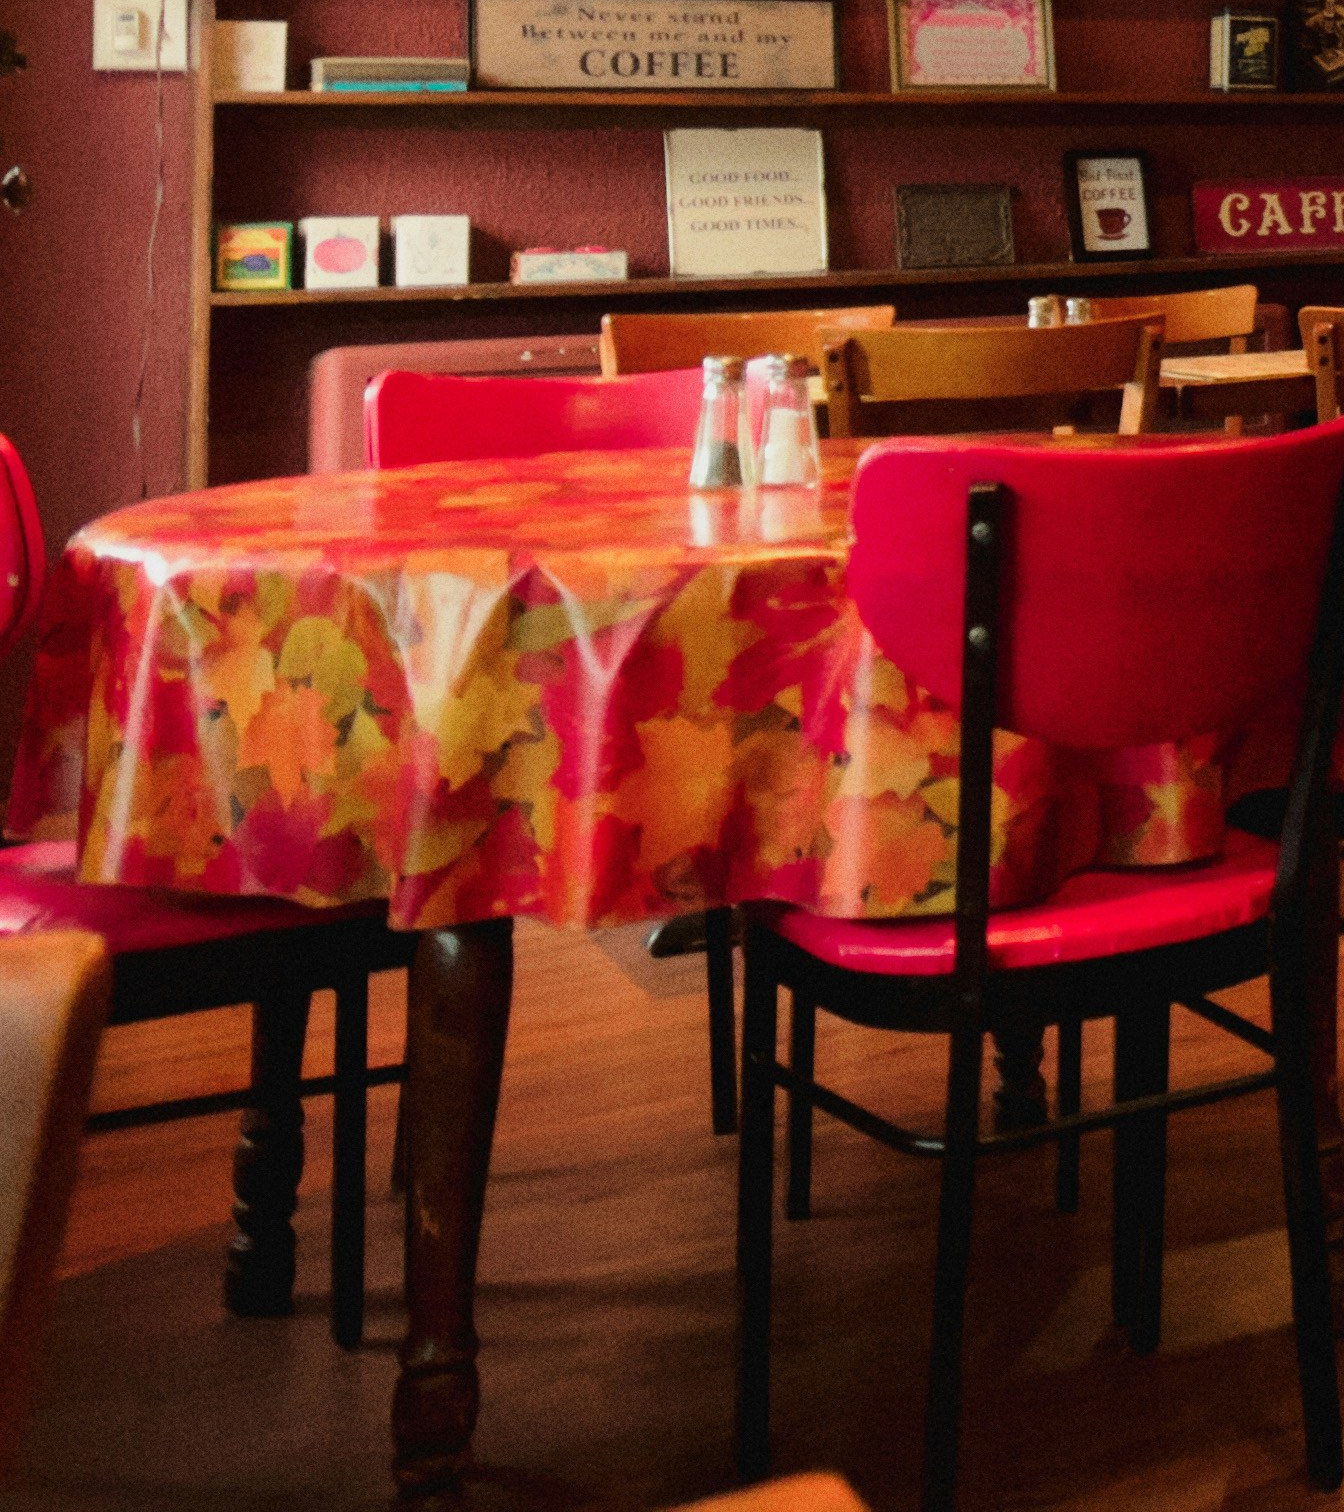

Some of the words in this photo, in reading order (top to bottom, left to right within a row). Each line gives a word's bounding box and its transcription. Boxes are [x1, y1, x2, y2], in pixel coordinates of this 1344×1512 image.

[577, 5, 655, 23] Never
[669, 8, 741, 26] stand
[521, 23, 638, 43] Between
[648, 29, 686, 43] me
[697, 28, 745, 45] and
[757, 32, 792, 49] my
[579, 49, 740, 80] COFFEE
[689, 172, 739, 184] GOOD
[1083, 188, 1137, 201] COFFEE
[679, 195, 729, 209] GOOD
[690, 219, 740, 233] GOOD
